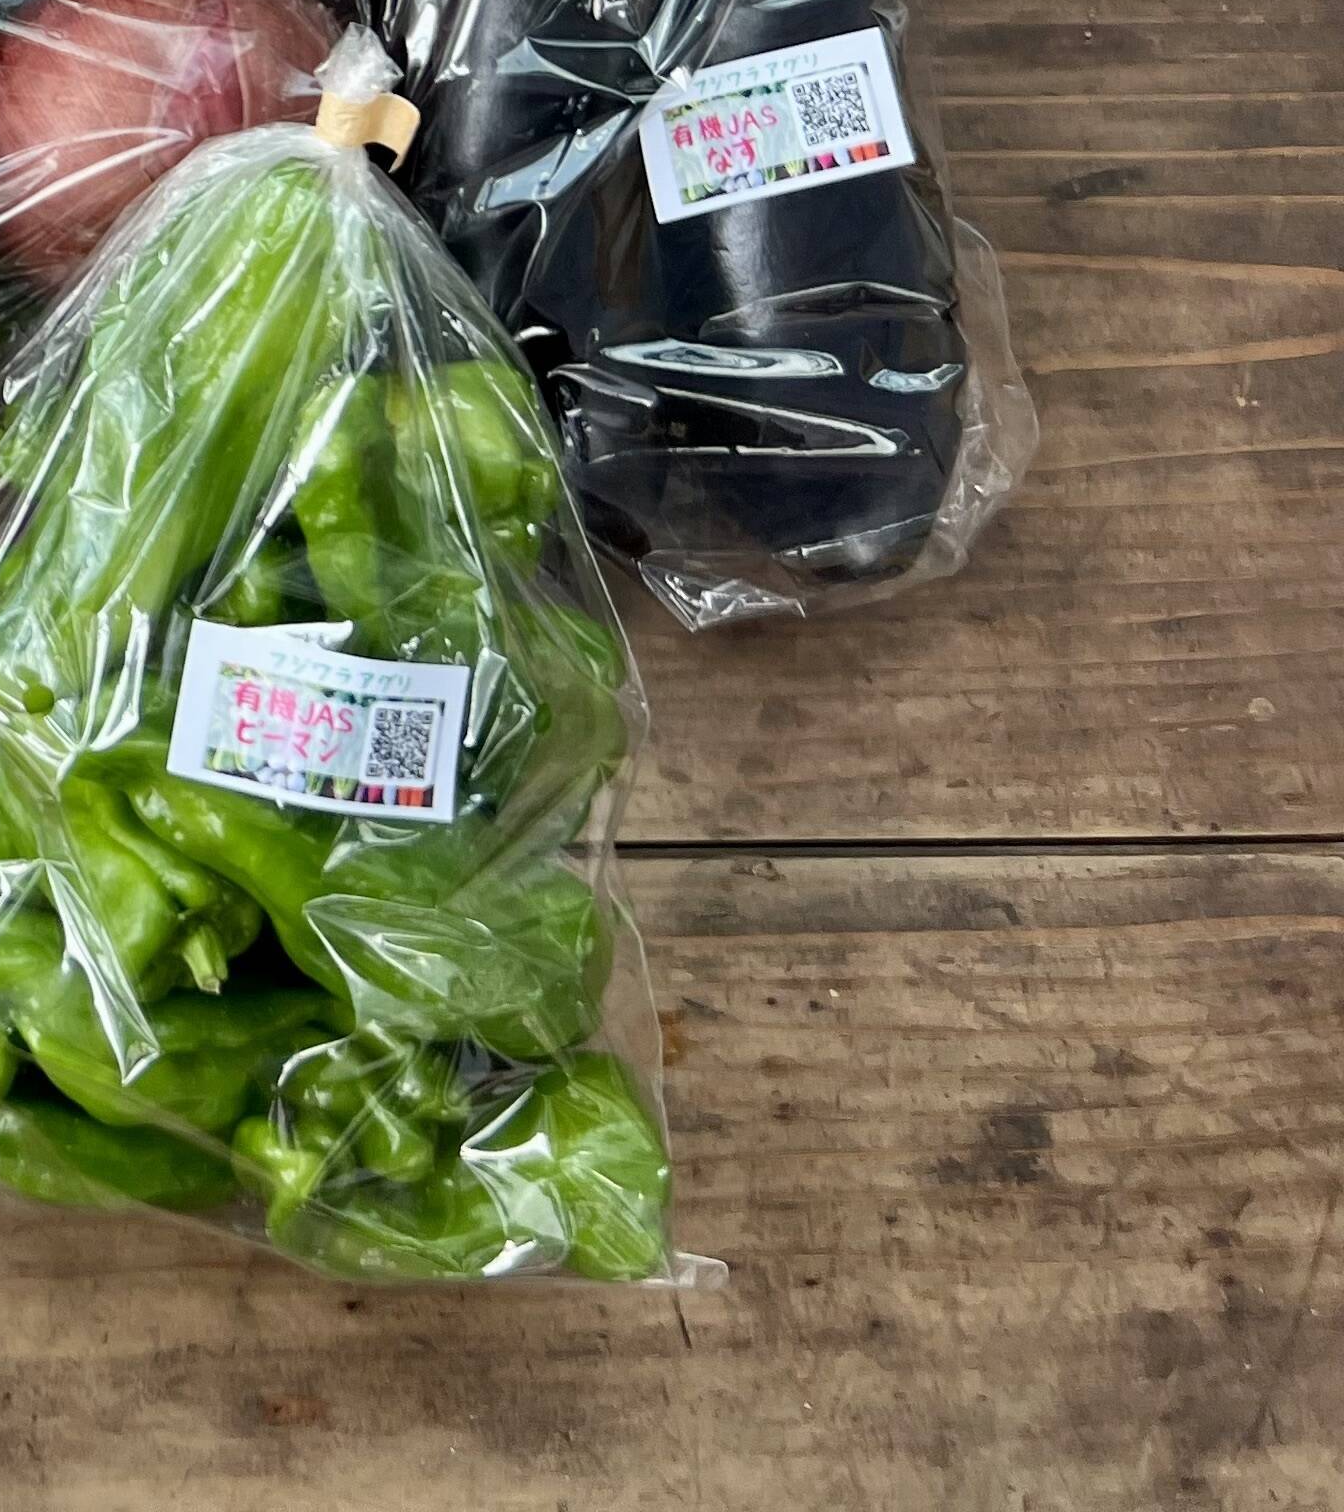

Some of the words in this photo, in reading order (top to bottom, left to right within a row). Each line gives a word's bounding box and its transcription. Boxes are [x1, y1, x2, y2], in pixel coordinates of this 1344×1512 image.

[695, 54, 818, 93] フジワラアグリ
[672, 105, 779, 148] 有機JAS
[707, 137, 758, 174] なす
[271, 651, 411, 692] フジワラアグリ
[236, 719, 341, 764] ピーマン
